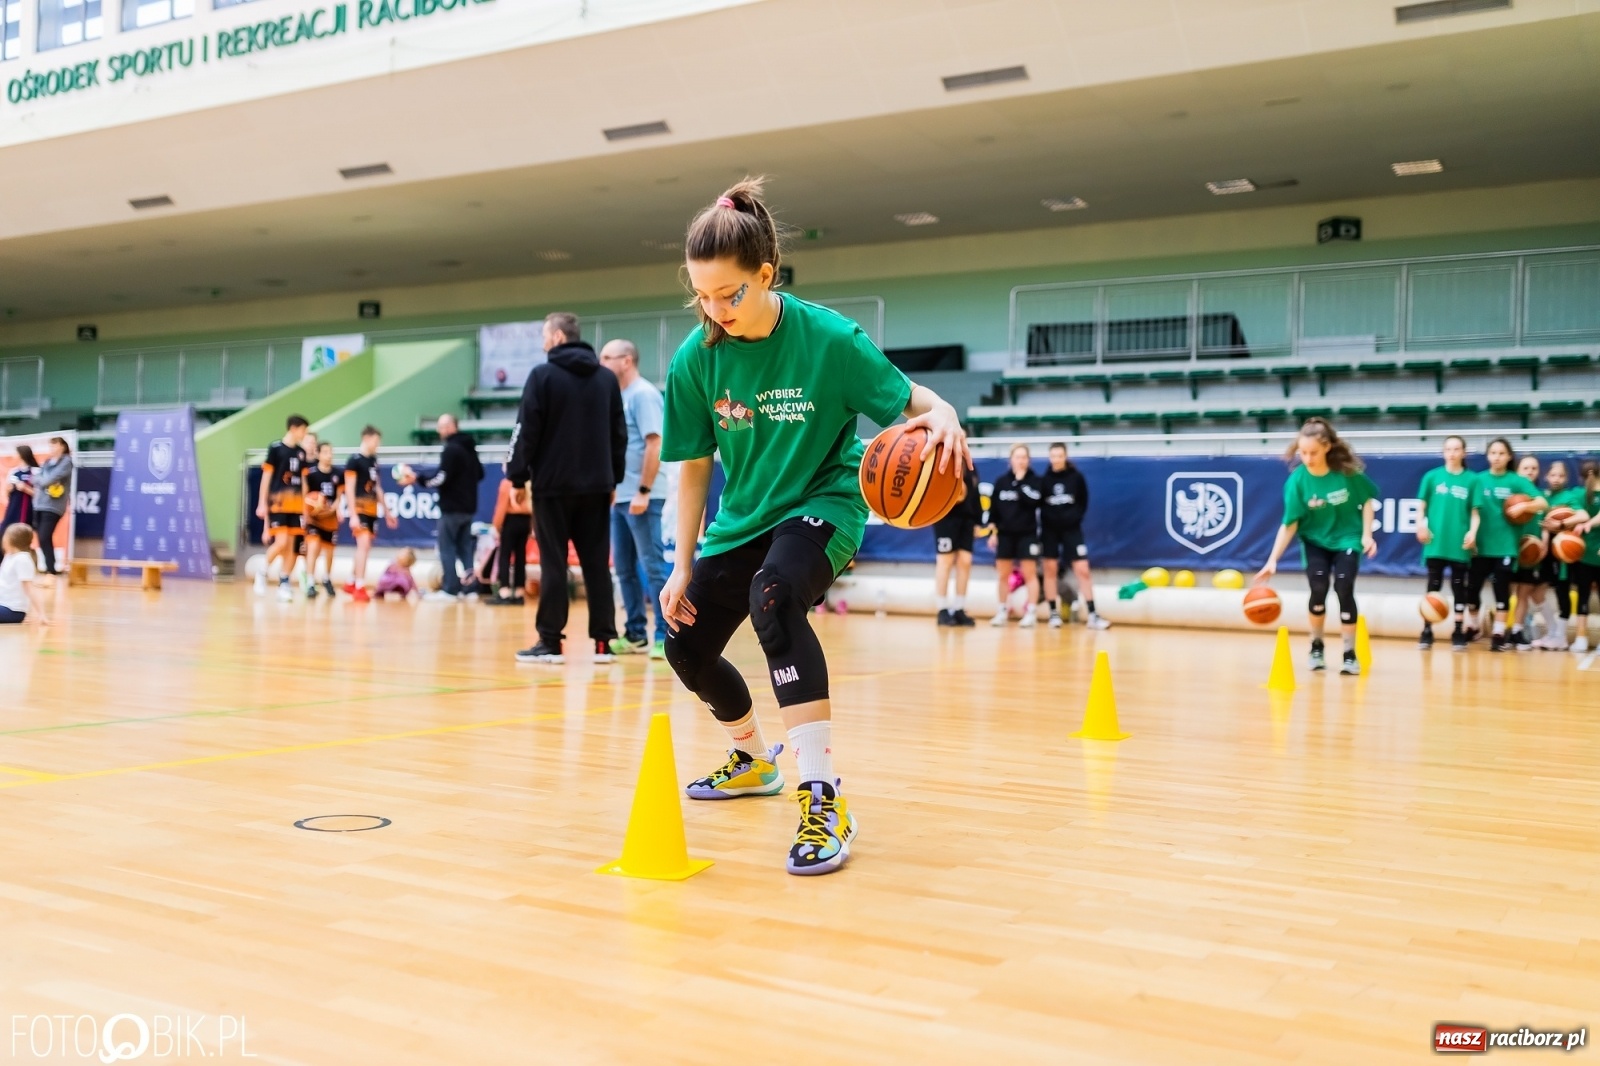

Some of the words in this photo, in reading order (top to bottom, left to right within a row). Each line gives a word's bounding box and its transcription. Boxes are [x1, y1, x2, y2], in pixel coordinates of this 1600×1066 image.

[7, 60, 99, 104] OŚRODEK
[108, 38, 193, 82] SPORTU
[203, 35, 208, 62] I
[217, 4, 347, 59] REKREACJI
[358, 0, 496, 29] RACIB
[755, 388, 803, 402] WYBIERZ
[866, 440, 886, 486] 365
[890, 438, 918, 498] molten
[778, 665, 800, 685] NBA
